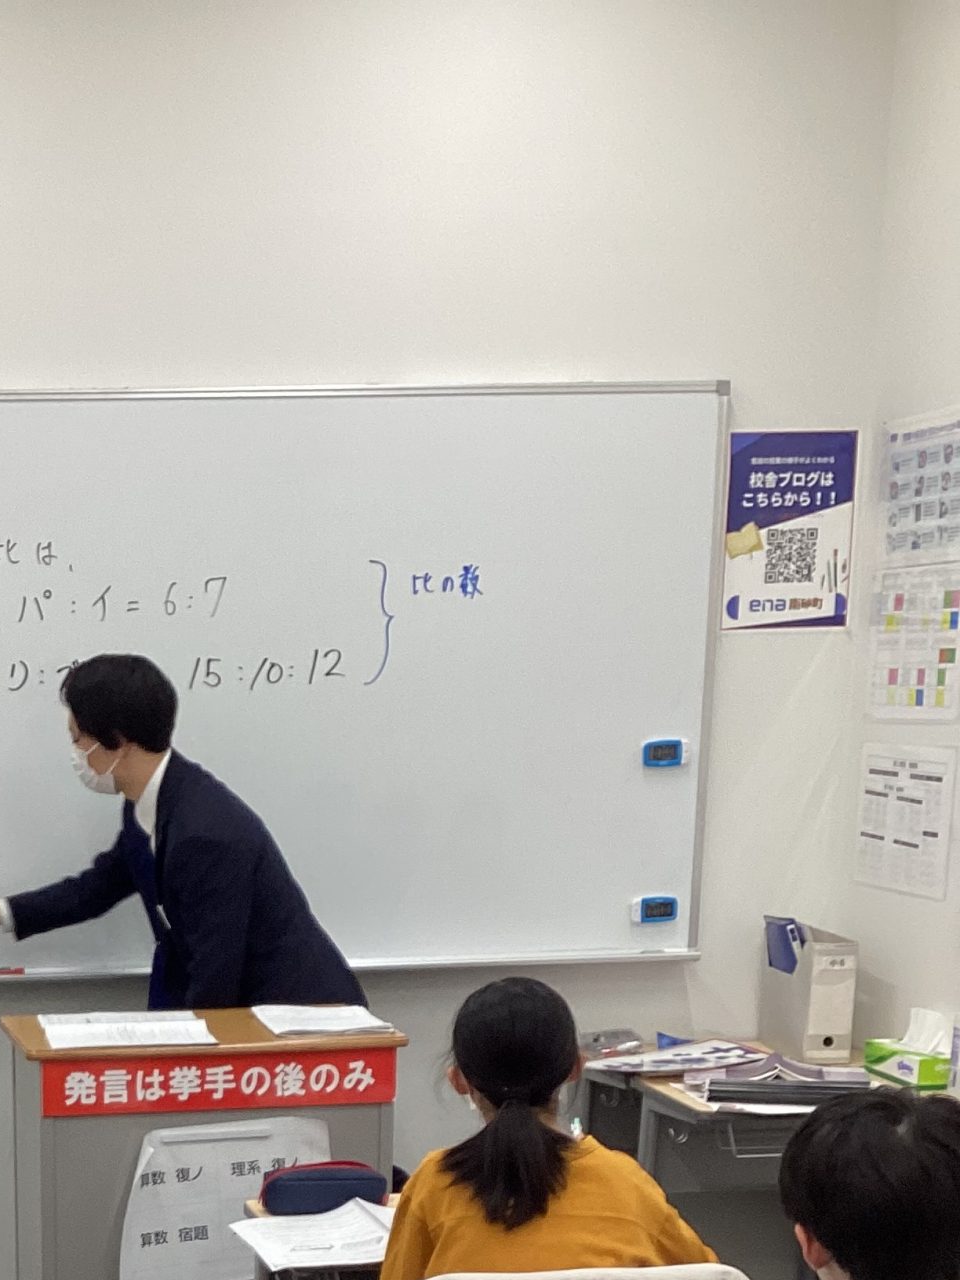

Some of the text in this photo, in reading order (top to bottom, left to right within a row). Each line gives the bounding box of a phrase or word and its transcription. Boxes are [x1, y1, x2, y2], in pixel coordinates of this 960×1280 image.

[748, 471, 836, 489] 校舎ブログは
[749, 598, 787, 612] ena
[64, 1060, 375, 1106] 発言は挙手の後のみ
[140, 1171, 166, 1187] 算数
[230, 1159, 262, 1177] 理系
[140, 1225, 209, 1248] 算数 宿題
